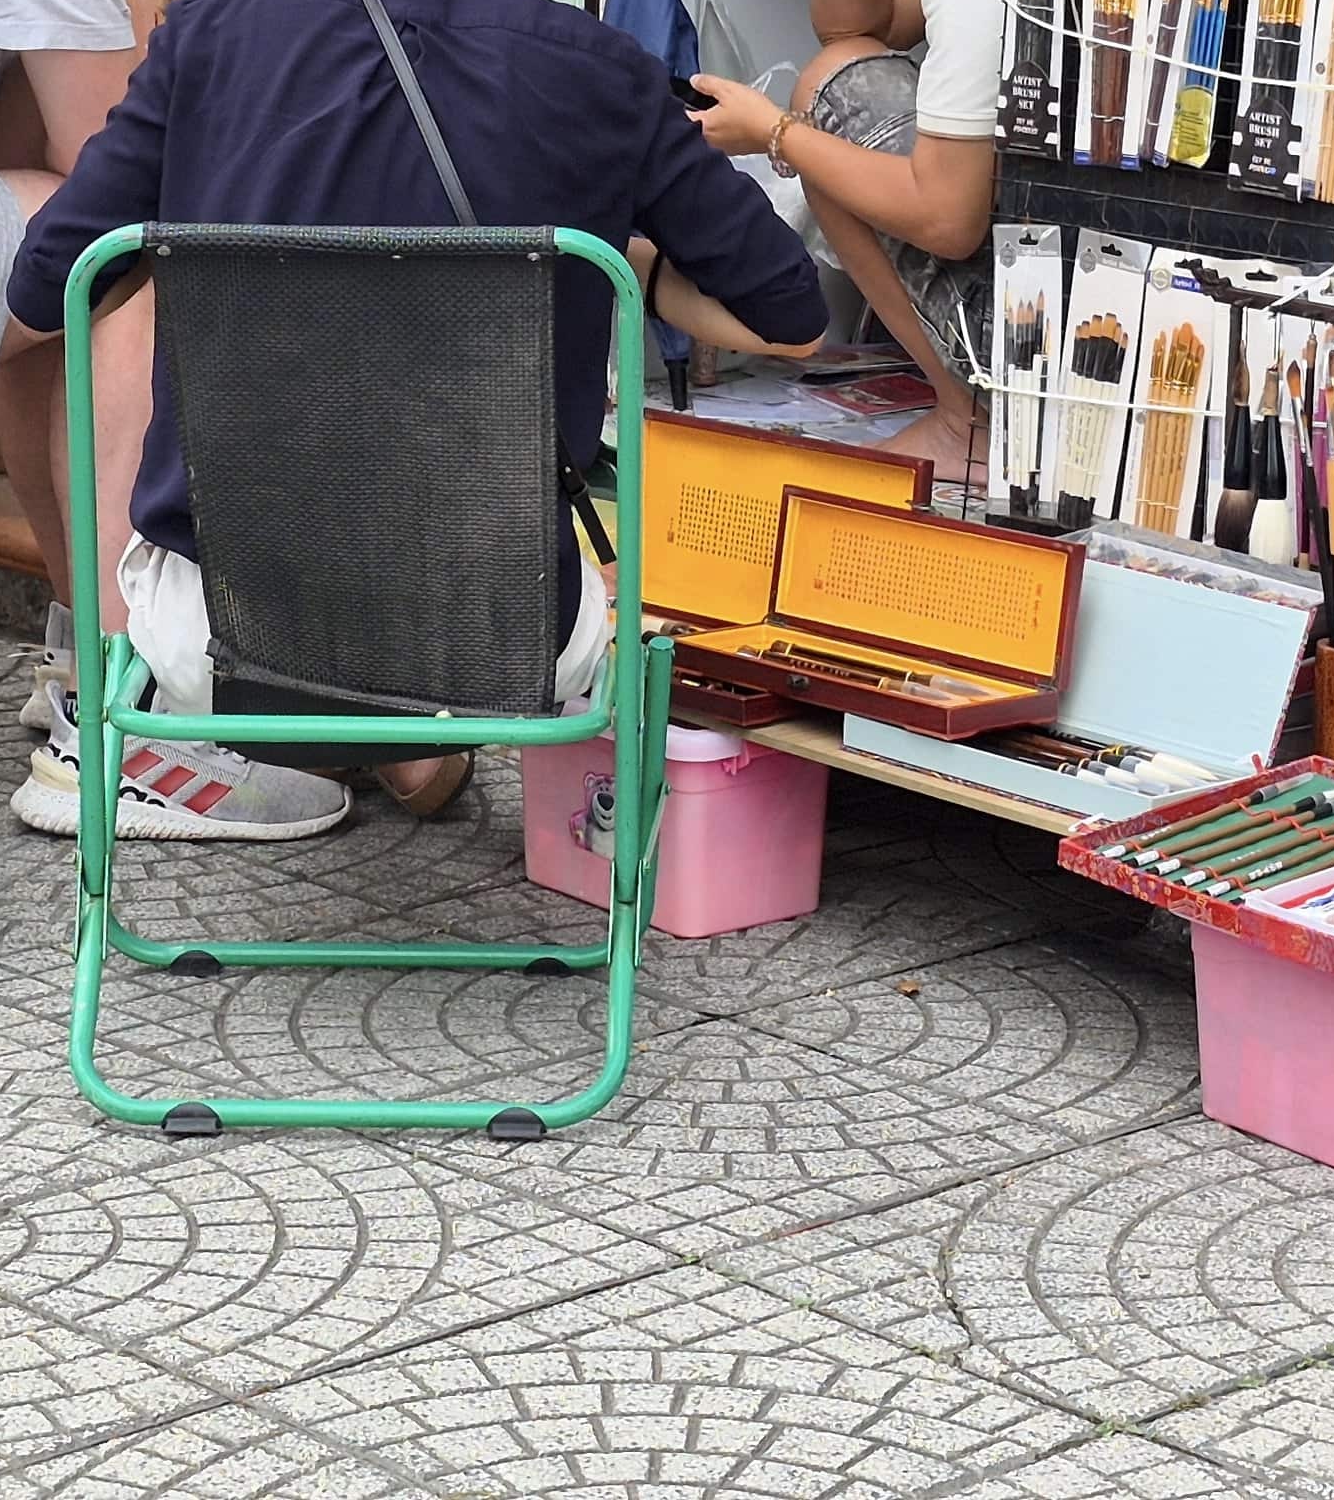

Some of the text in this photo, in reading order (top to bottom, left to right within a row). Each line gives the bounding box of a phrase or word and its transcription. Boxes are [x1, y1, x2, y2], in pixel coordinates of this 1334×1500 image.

[1012, 73, 1043, 87] ARTIST
[1012, 86, 1040, 99] BRUSH
[1248, 111, 1283, 126] ARTIST
[1248, 123, 1280, 139] BRUSH
[1254, 137, 1273, 150] SET
